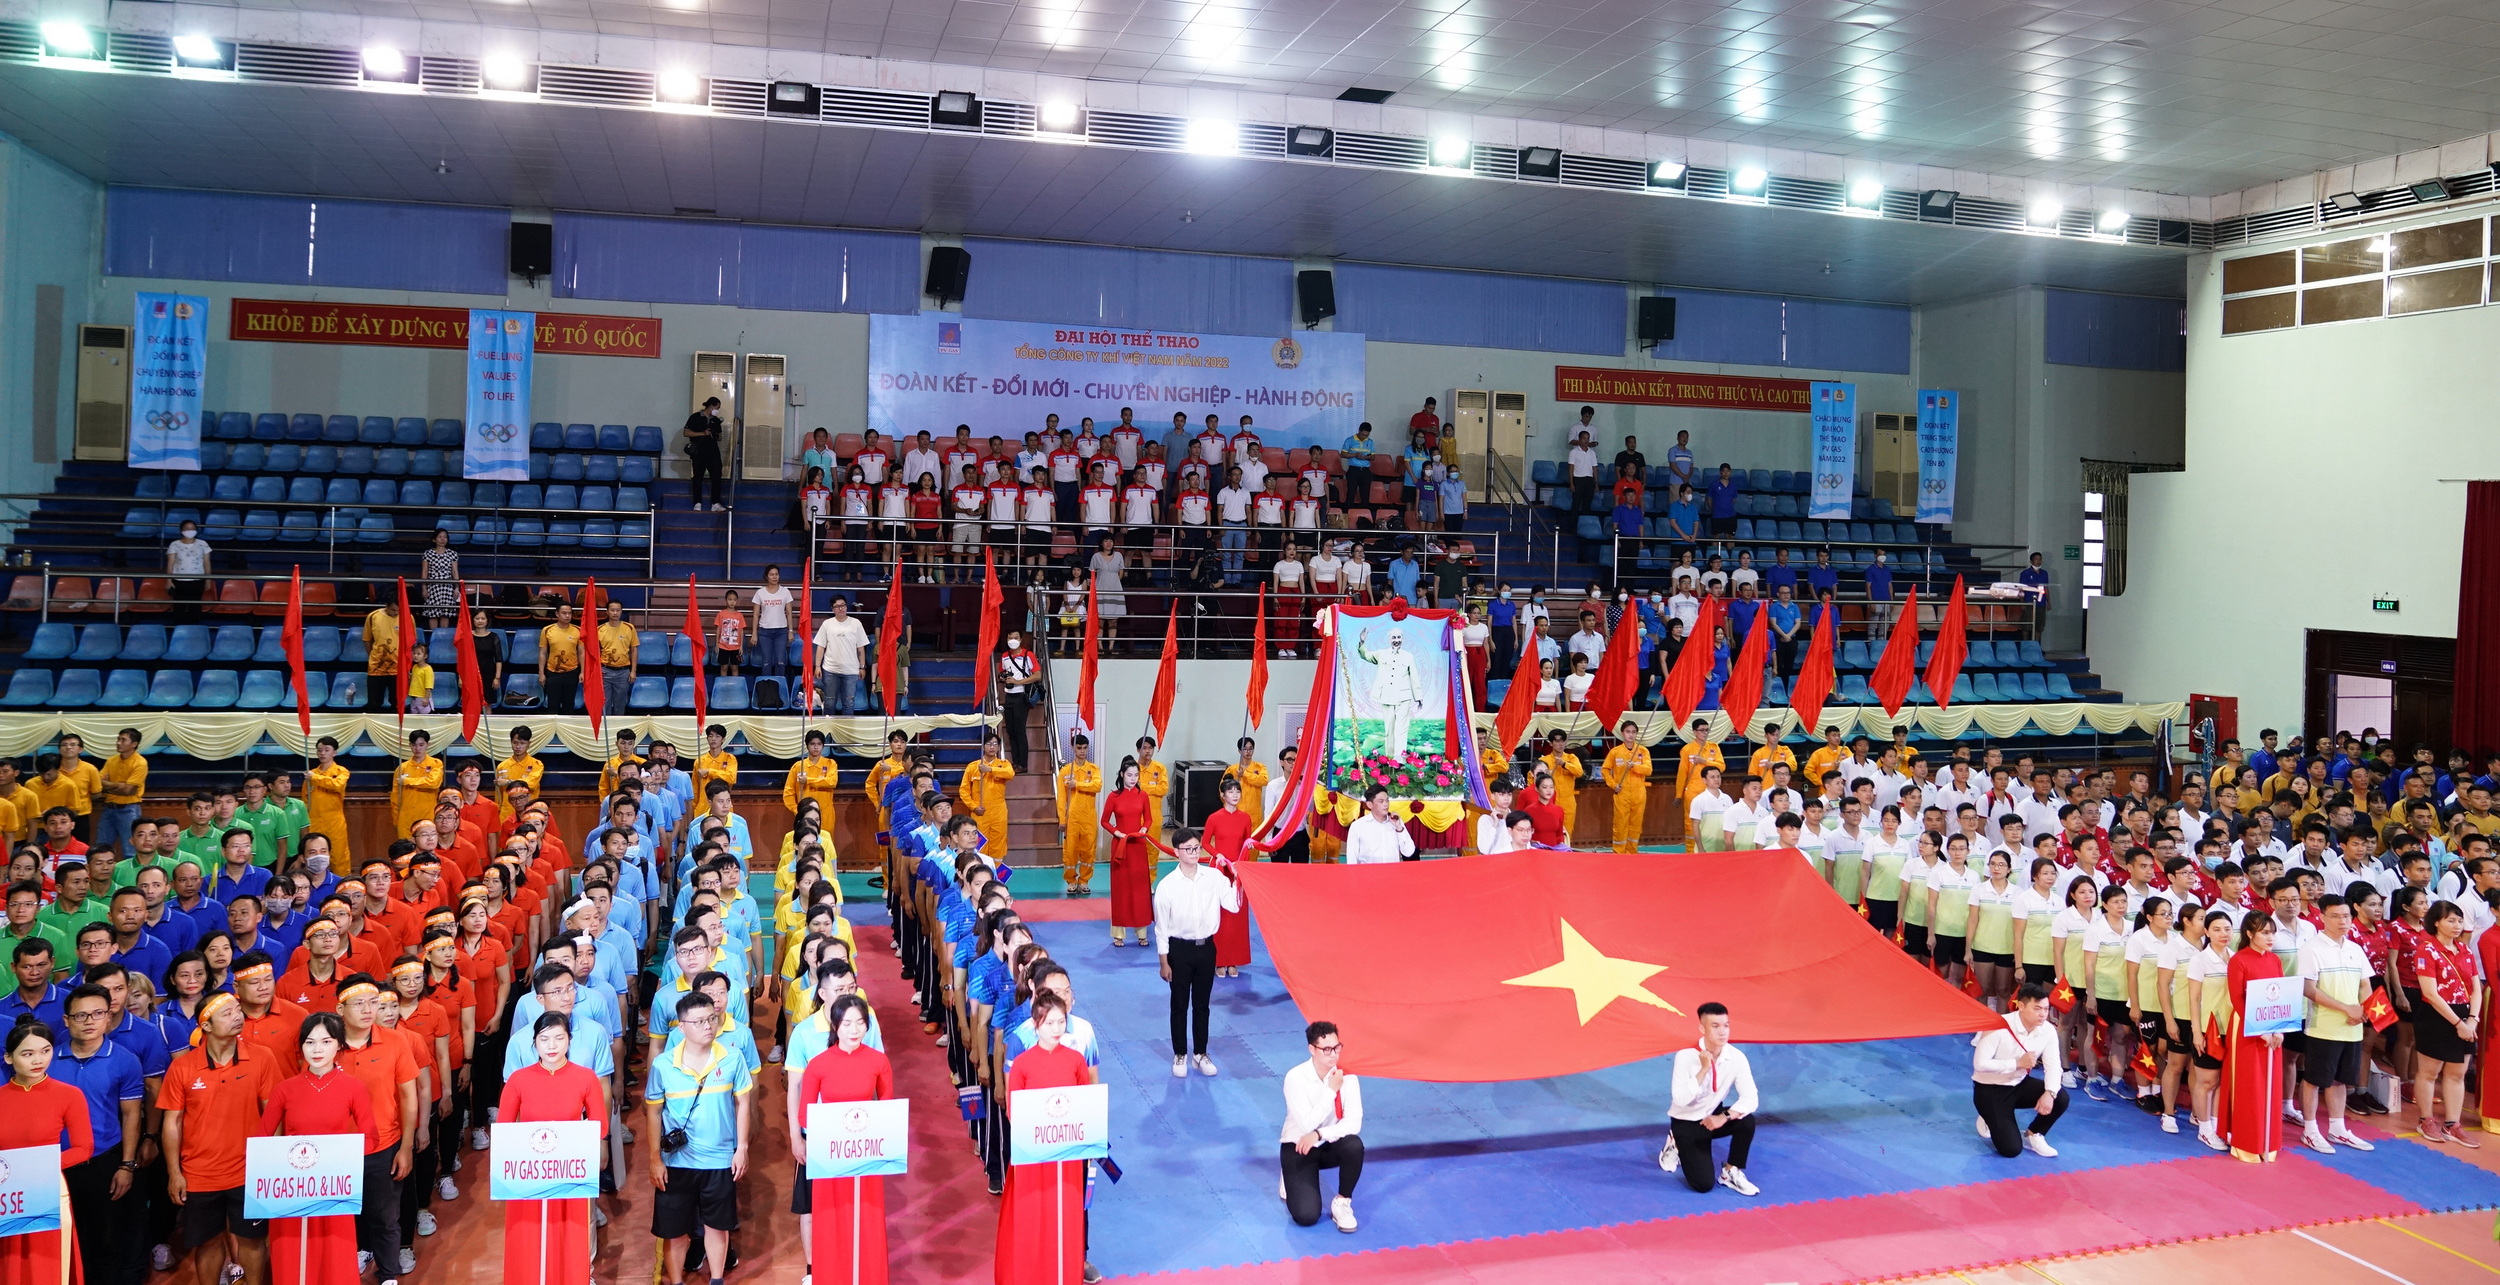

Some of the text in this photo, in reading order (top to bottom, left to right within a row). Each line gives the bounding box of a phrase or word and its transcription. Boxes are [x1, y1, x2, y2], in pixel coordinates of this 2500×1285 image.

[247, 308, 469, 341] KHỎE ĐỂ XÂY DỰNG V
[563, 320, 588, 344] TỔ
[594, 323, 647, 349] QUỐC
[1055, 330, 1200, 349] ĐẠI HỘI THỂ THAO
[477, 351, 523, 362] FUELLING
[1015, 343, 1230, 368] TỔNG CÔNG TY KHÍ VIỆT NAM NĂM 2022
[482, 371, 517, 381] VALUES
[483, 391, 516, 401] TO LIFE
[879, 371, 938, 392] ĐOÀN
[943, 372, 978, 393] KẾT
[992, 374, 1027, 396] ĐỔI
[1033, 377, 1069, 397] MỚI
[1084, 382, 1159, 402] CHUYÊN
[1164, 384, 1231, 407] NGHIỆP
[1245, 387, 1297, 406] HÀNH
[1301, 389, 1354, 411] ĐỘNG
[1563, 378, 1583, 393] THI
[1587, 373, 1611, 395] ĐẤU
[1614, 378, 1646, 396] ĐOÀN
[1649, 376, 1674, 400] KẾT,
[1677, 384, 1715, 399] TRUNG
[1717, 385, 1748, 404] THỰC
[1750, 384, 1764, 402] VÀ
[1768, 388, 1790, 403] CAO
[2376, 601, 2395, 610] EXIT
[2255, 1004, 2292, 1022] CNG VIETNAM
[1034, 1122, 1085, 1144] PVCOATING
[830, 1138, 885, 1159] PV GAS PMC
[504, 1158, 587, 1180] PV GAS SERVICES
[256, 1175, 352, 1199] PV GAS H.O. & LNG
[10, 1191, 24, 1214] SE
